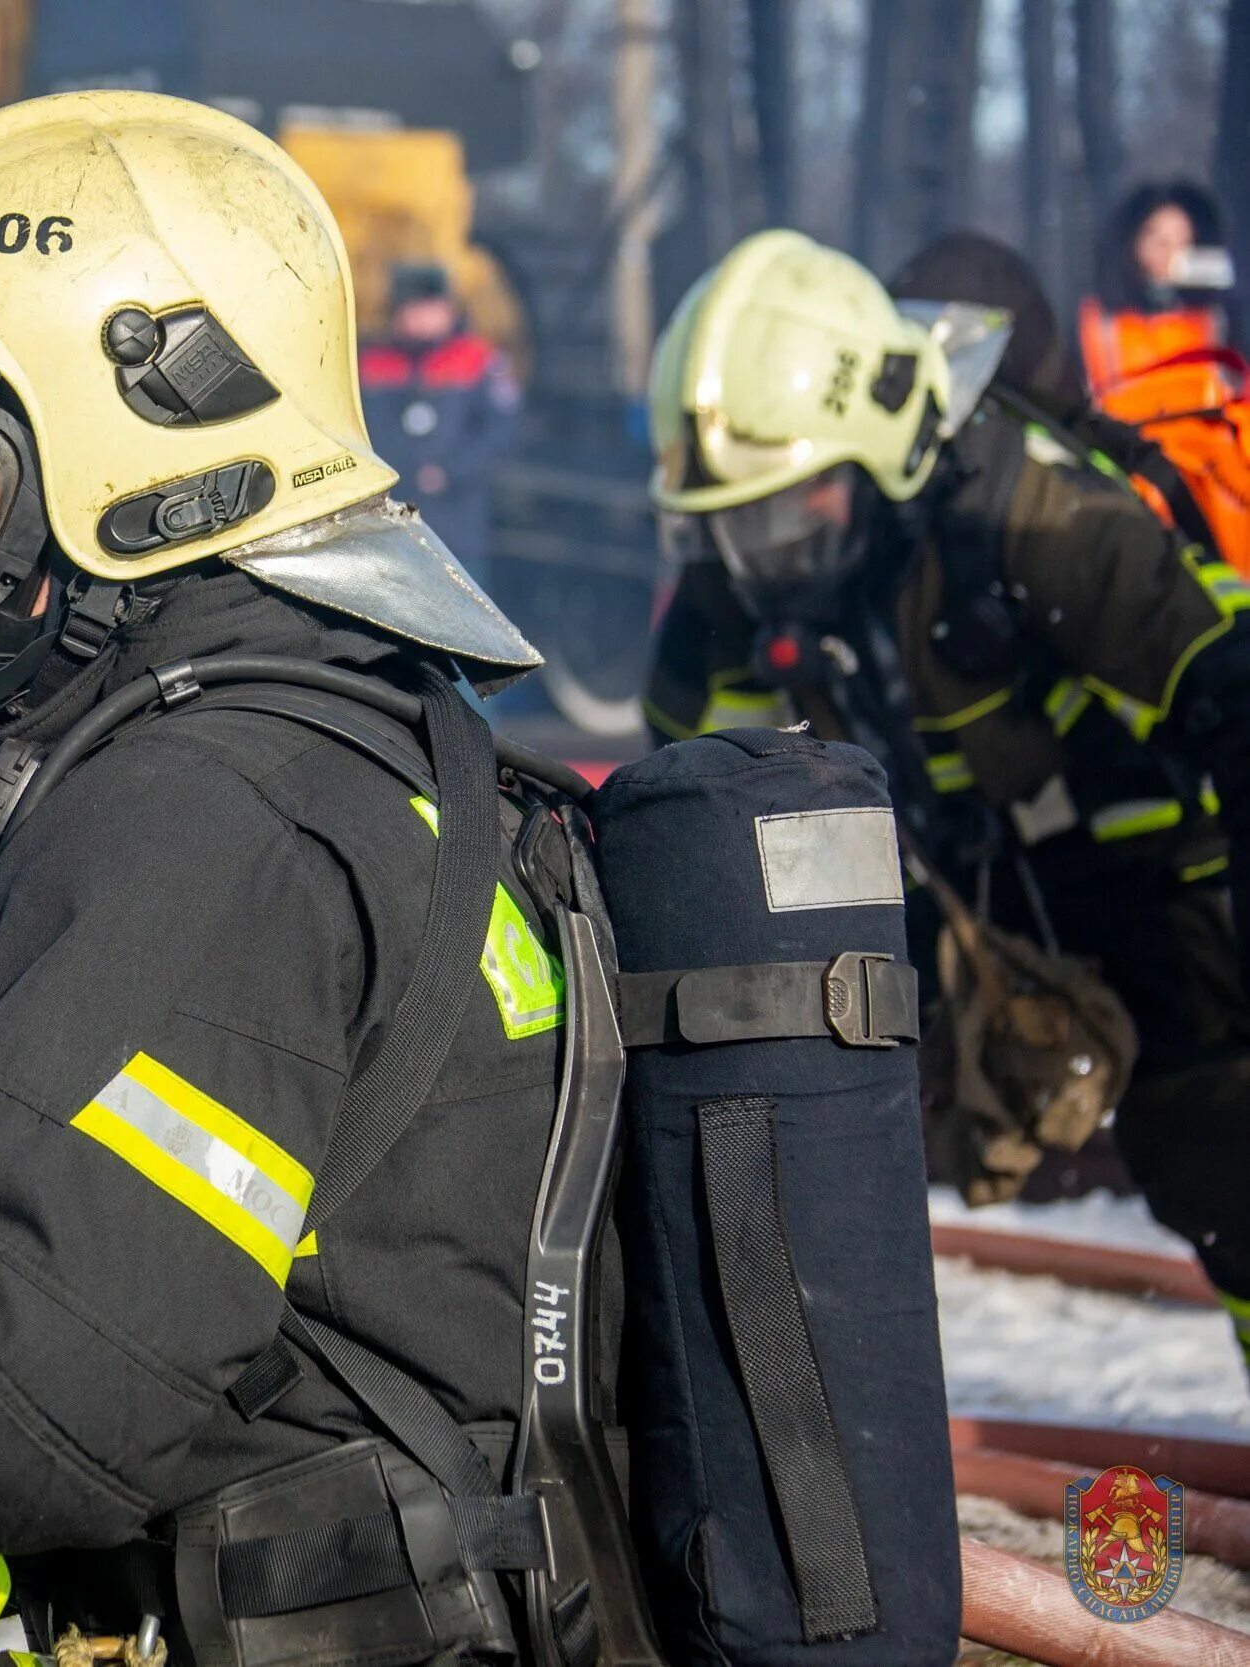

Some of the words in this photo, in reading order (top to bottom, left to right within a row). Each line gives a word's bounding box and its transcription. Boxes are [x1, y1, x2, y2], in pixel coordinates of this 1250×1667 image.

[171, 344, 218, 386] MSA
[294, 468, 324, 488] MSA
[530, 1280, 571, 1386] 0744
